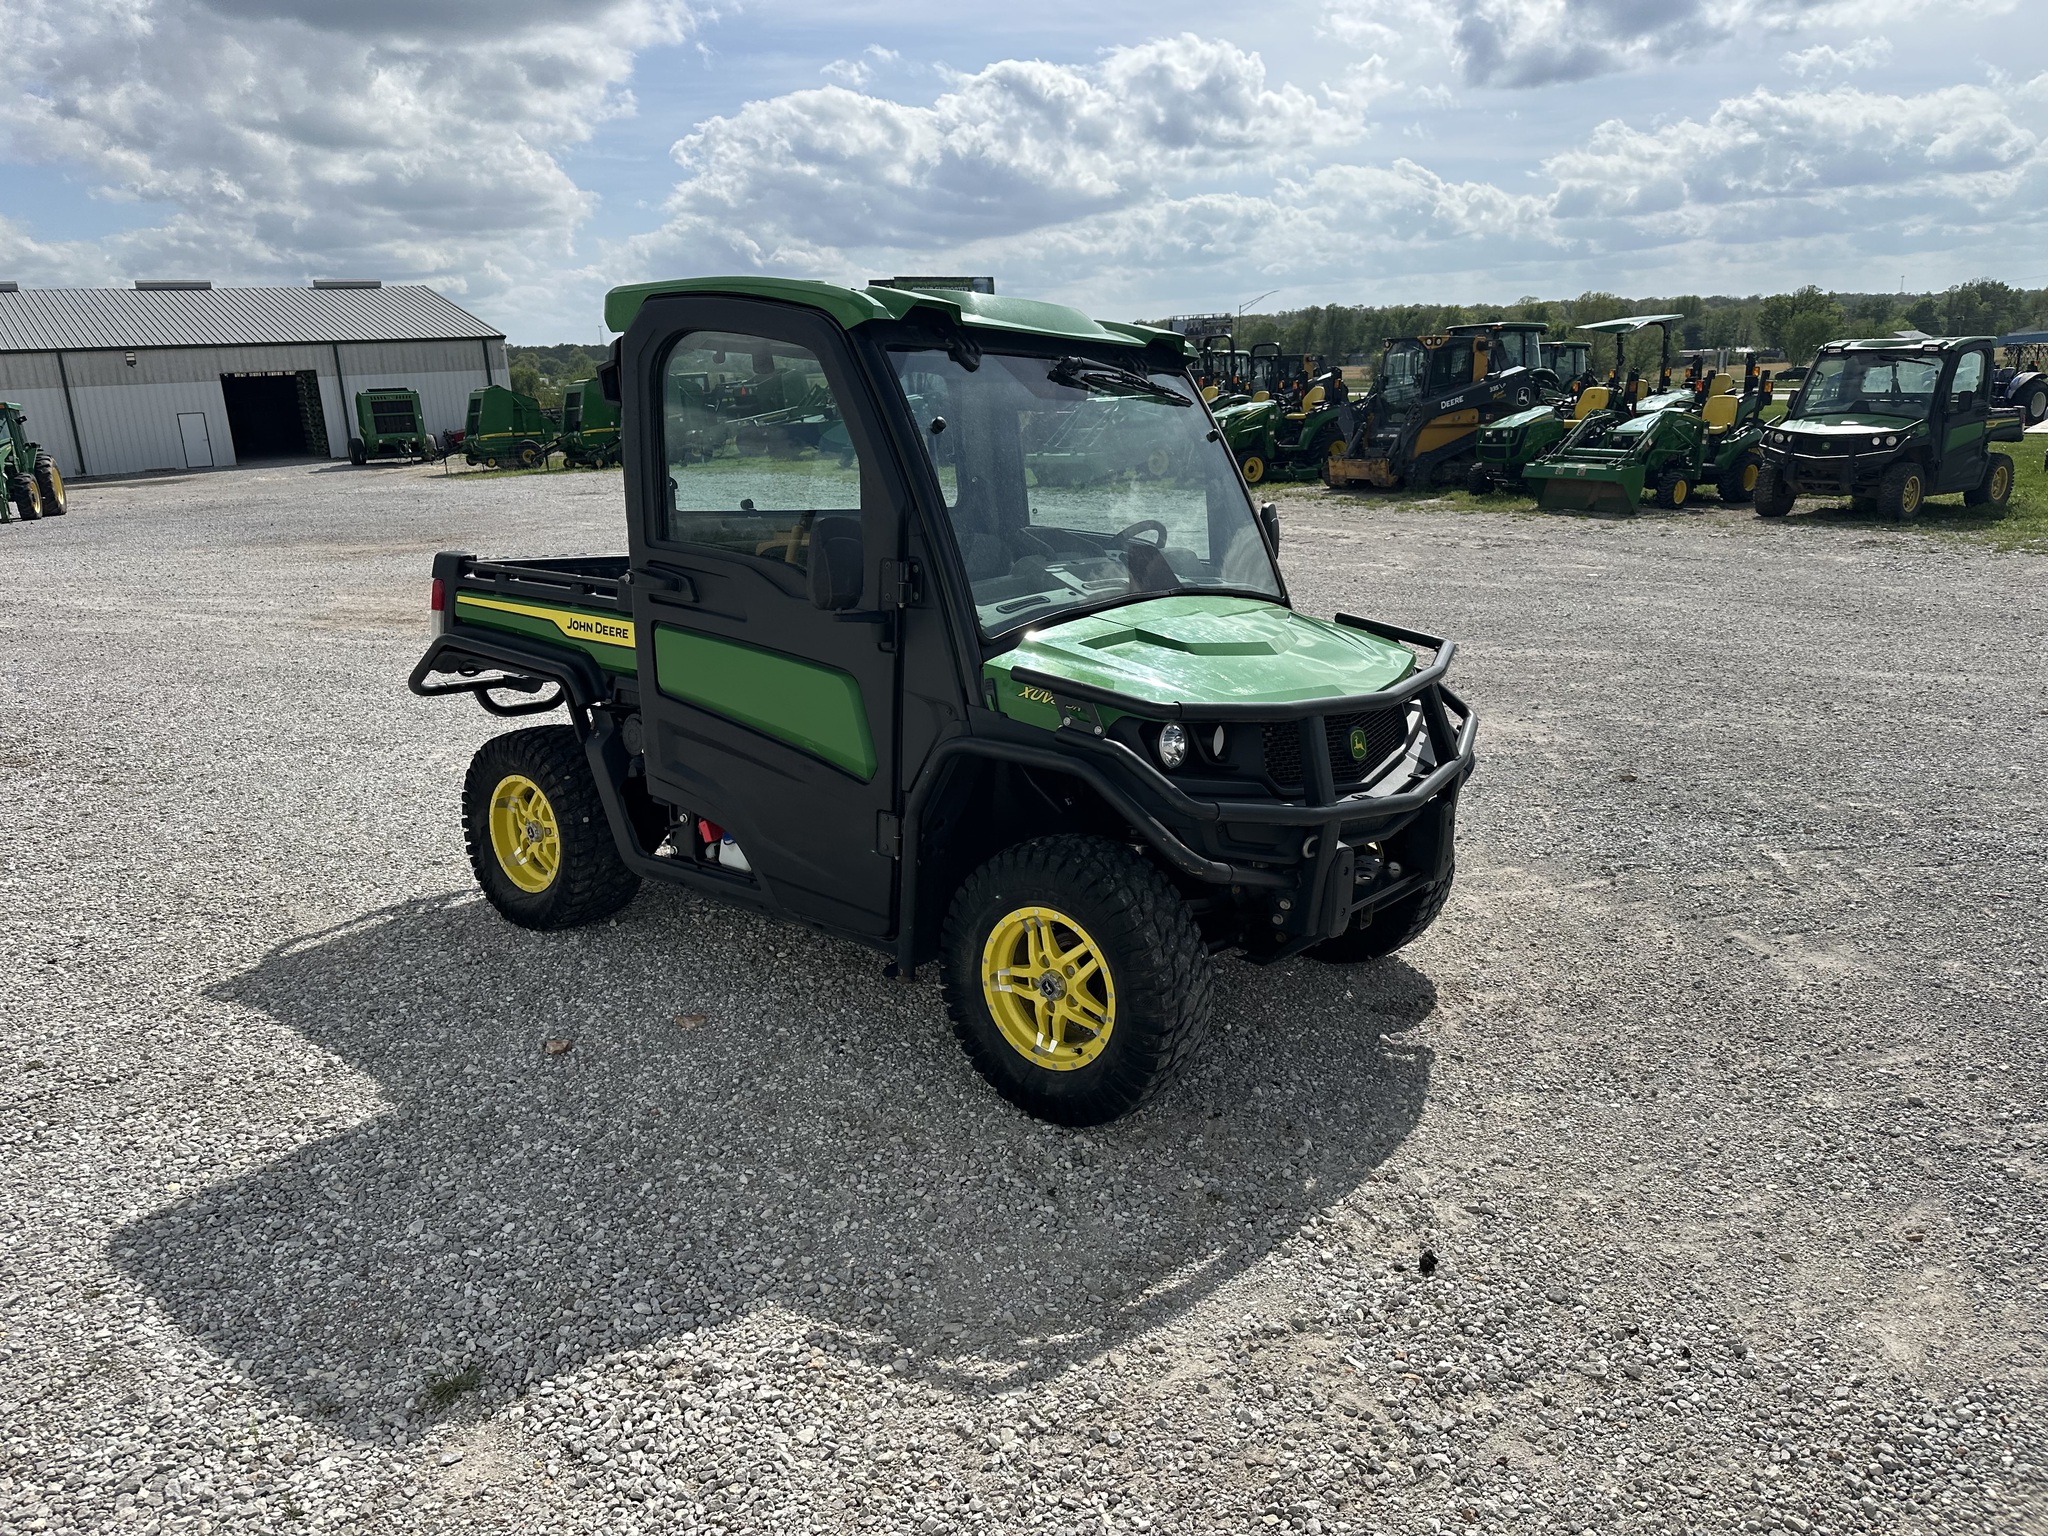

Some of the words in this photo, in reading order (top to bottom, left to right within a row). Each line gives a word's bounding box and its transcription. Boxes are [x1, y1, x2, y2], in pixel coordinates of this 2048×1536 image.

[1440, 395, 1464, 410] DEERE
[567, 618, 593, 633] JOHN
[595, 621, 629, 639] DEERE
